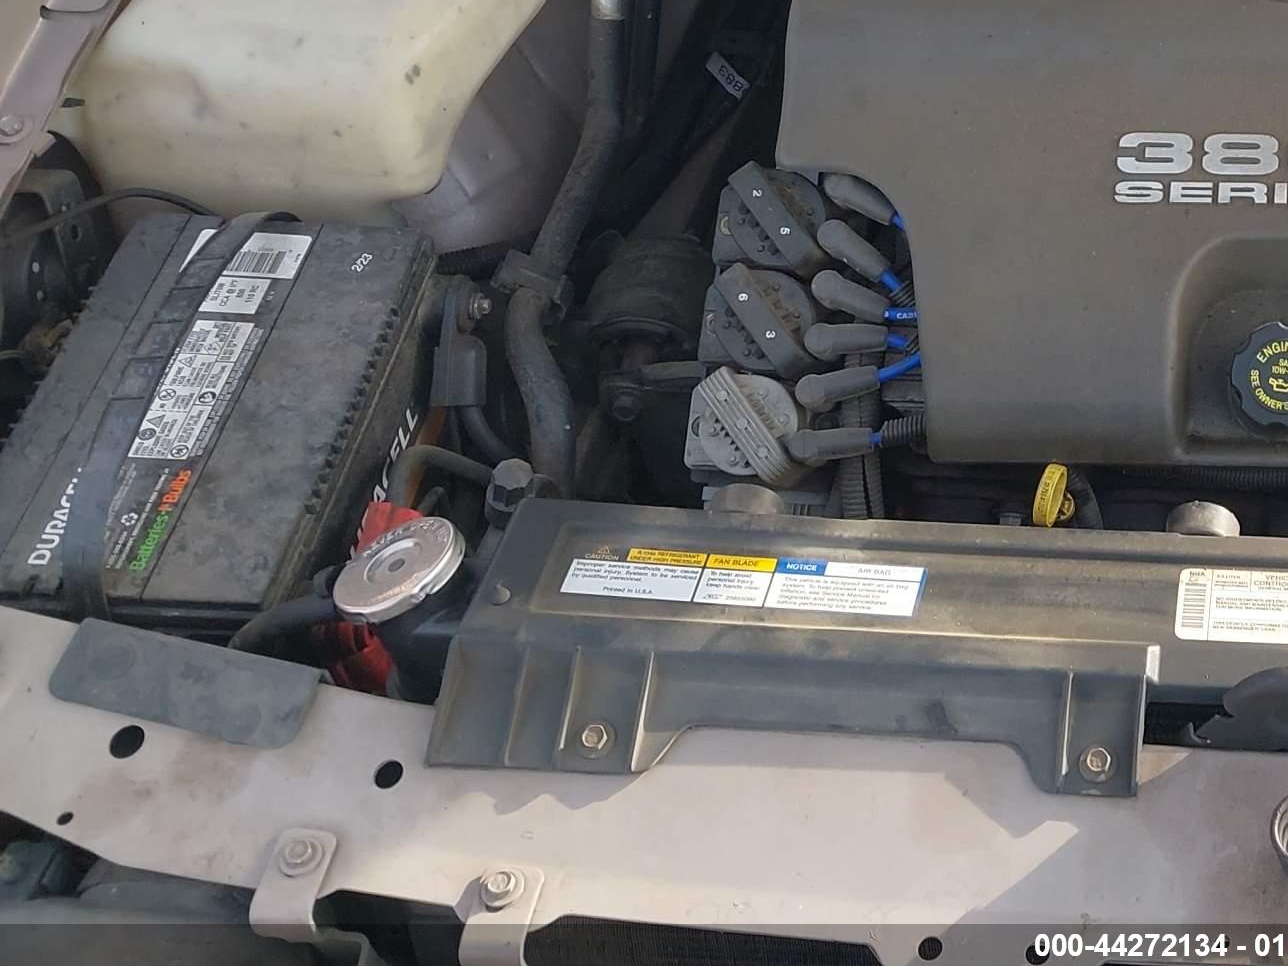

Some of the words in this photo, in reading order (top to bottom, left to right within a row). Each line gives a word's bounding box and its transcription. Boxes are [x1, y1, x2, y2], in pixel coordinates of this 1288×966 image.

[752, 188, 763, 198] 2
[780, 226, 791, 235] 5
[352, 253, 373, 273] 2/23
[738, 292, 749, 302] 6
[765, 330, 776, 339] 3
[1250, 369, 1261, 388] SEE
[576, 560, 604, 568] Improper
[785, 562, 817, 571] NOTICE
[581, 572, 608, 580] qualified
